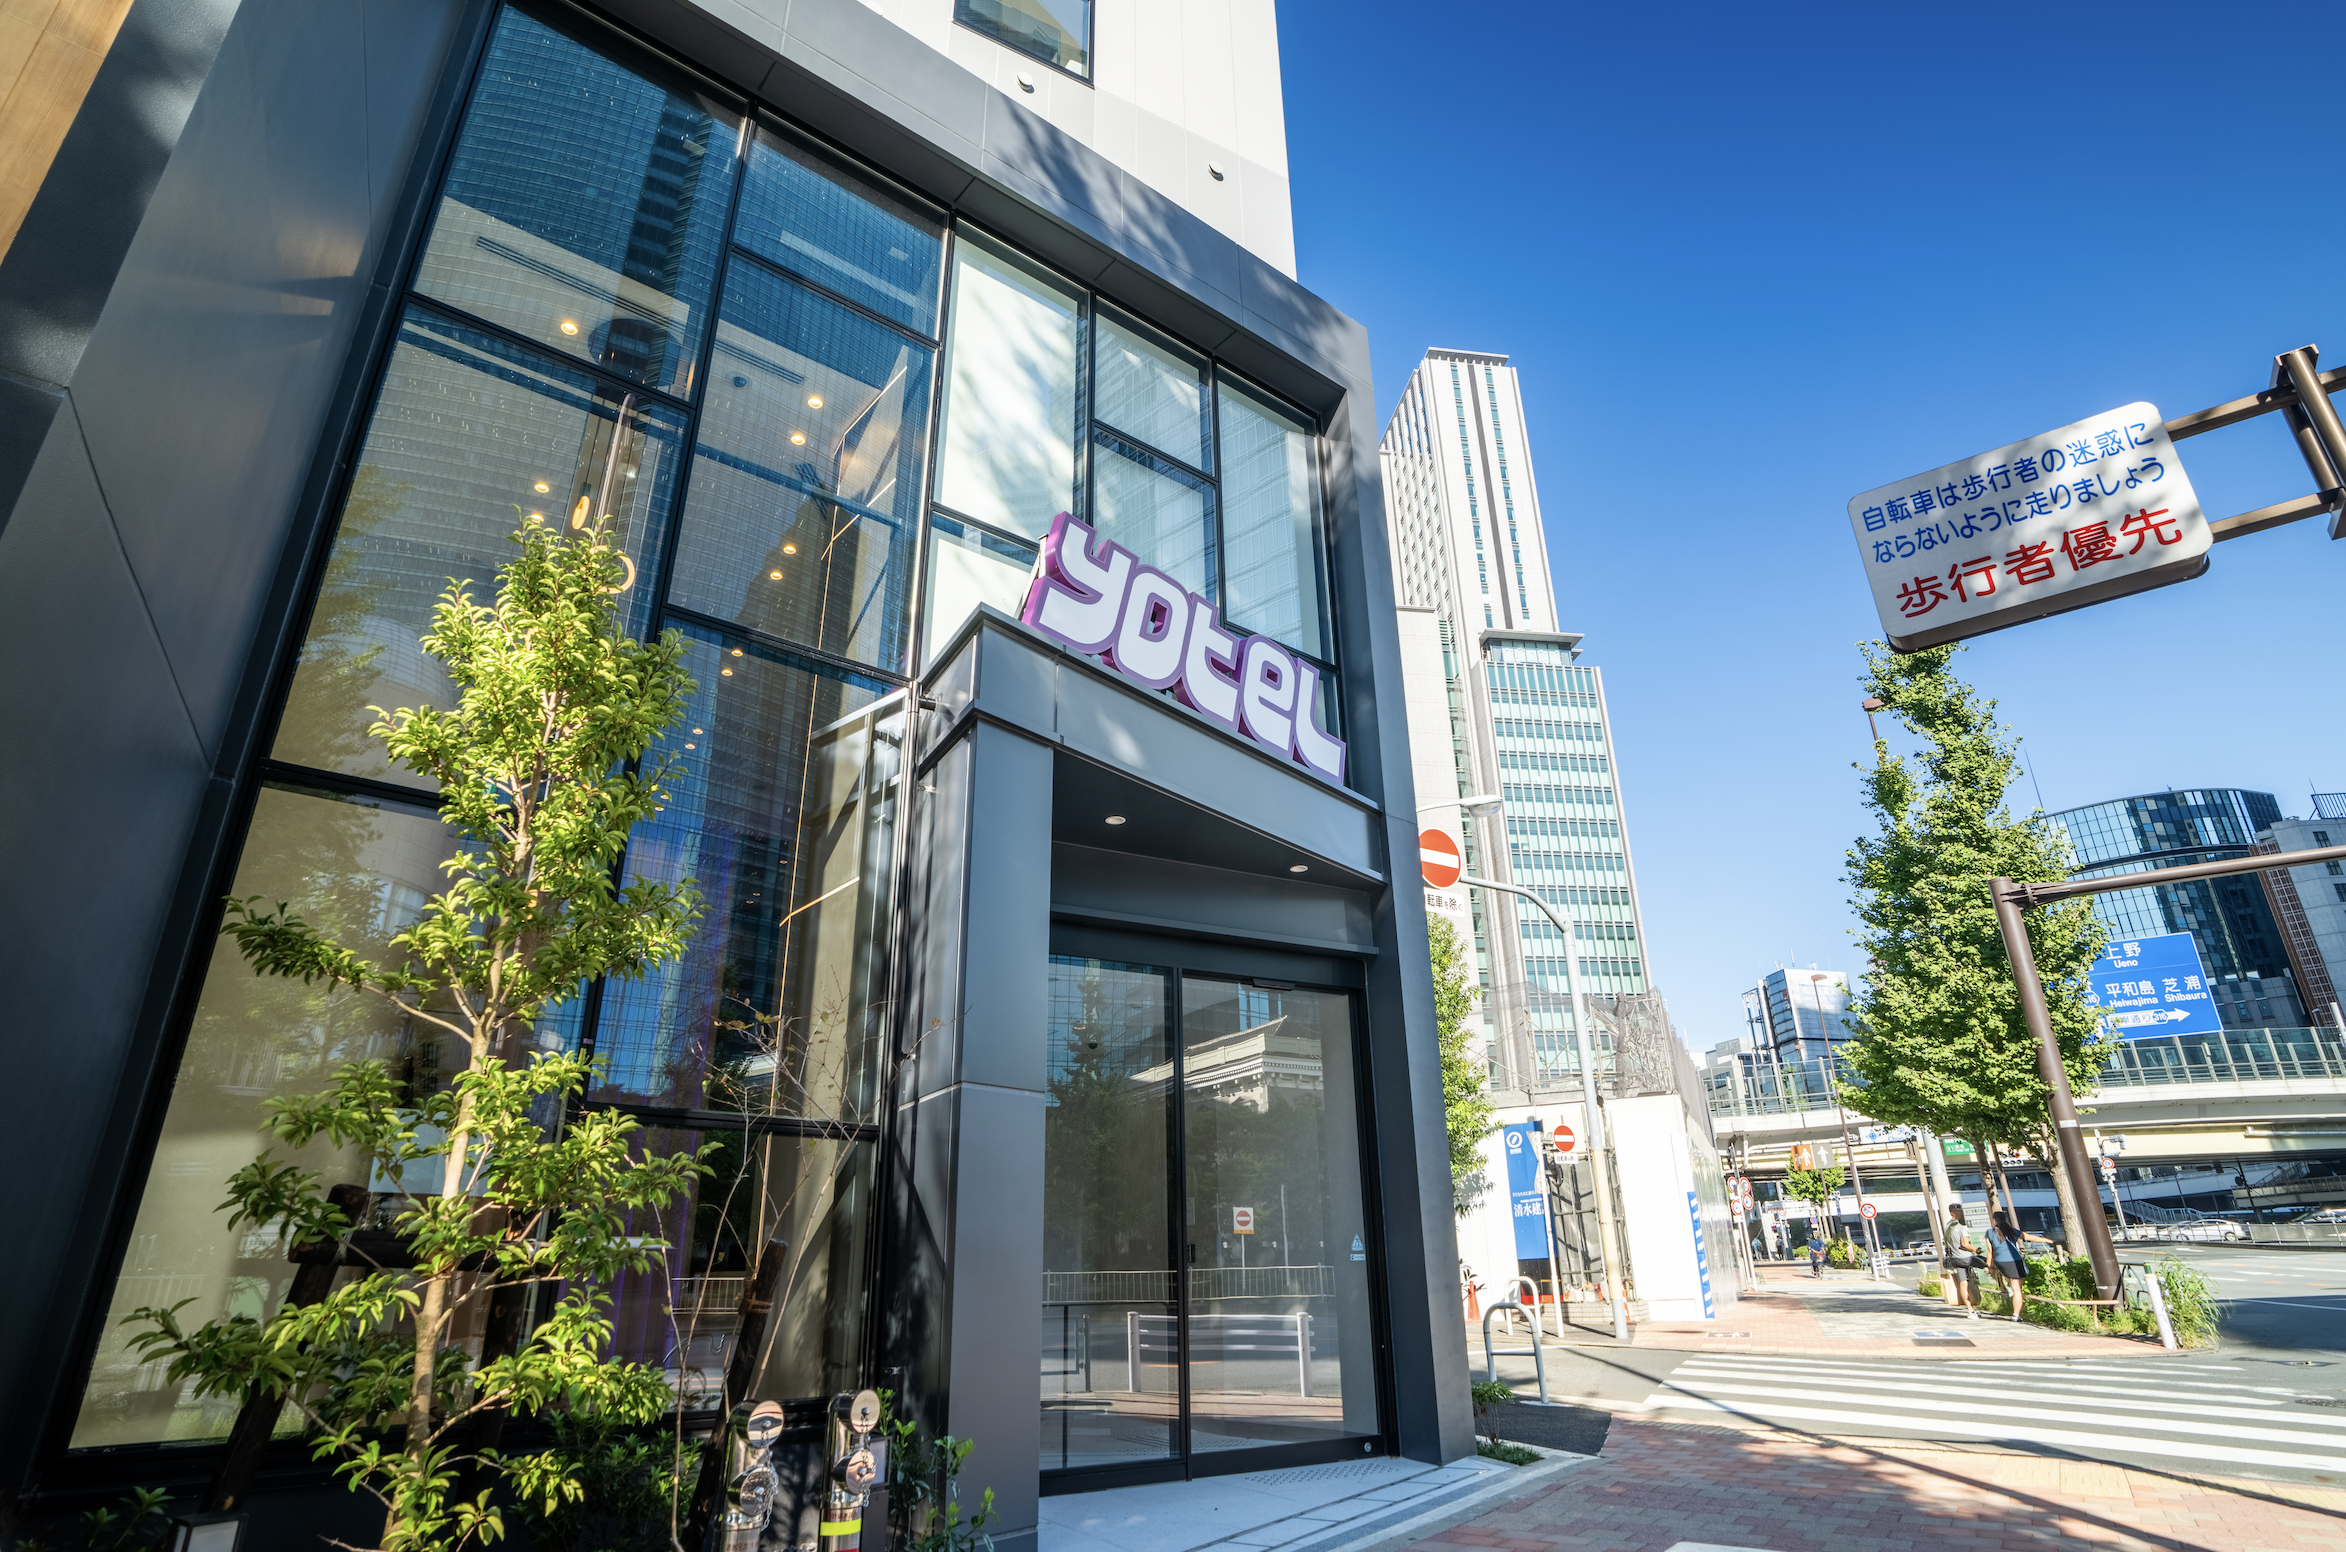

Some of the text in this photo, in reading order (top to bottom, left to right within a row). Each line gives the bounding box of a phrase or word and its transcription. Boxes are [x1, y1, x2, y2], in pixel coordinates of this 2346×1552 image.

[1862, 421, 2155, 533] 自転車は歩行者の迷惑に
[1872, 456, 2166, 565] ならないように走りましょう
[1896, 507, 2184, 619] 歩行者優先
[1426, 893, 1463, 912] 転車を除く
[2105, 941, 2142, 960] 上野
[2113, 958, 2139, 969] Ueno
[2104, 974, 2203, 999] 平和島 芝浦
[2109, 990, 2208, 1008] Heiwajima Shibaura
[2153, 1012, 2167, 1022] 316
[1514, 1201, 1545, 1218] 清水建
